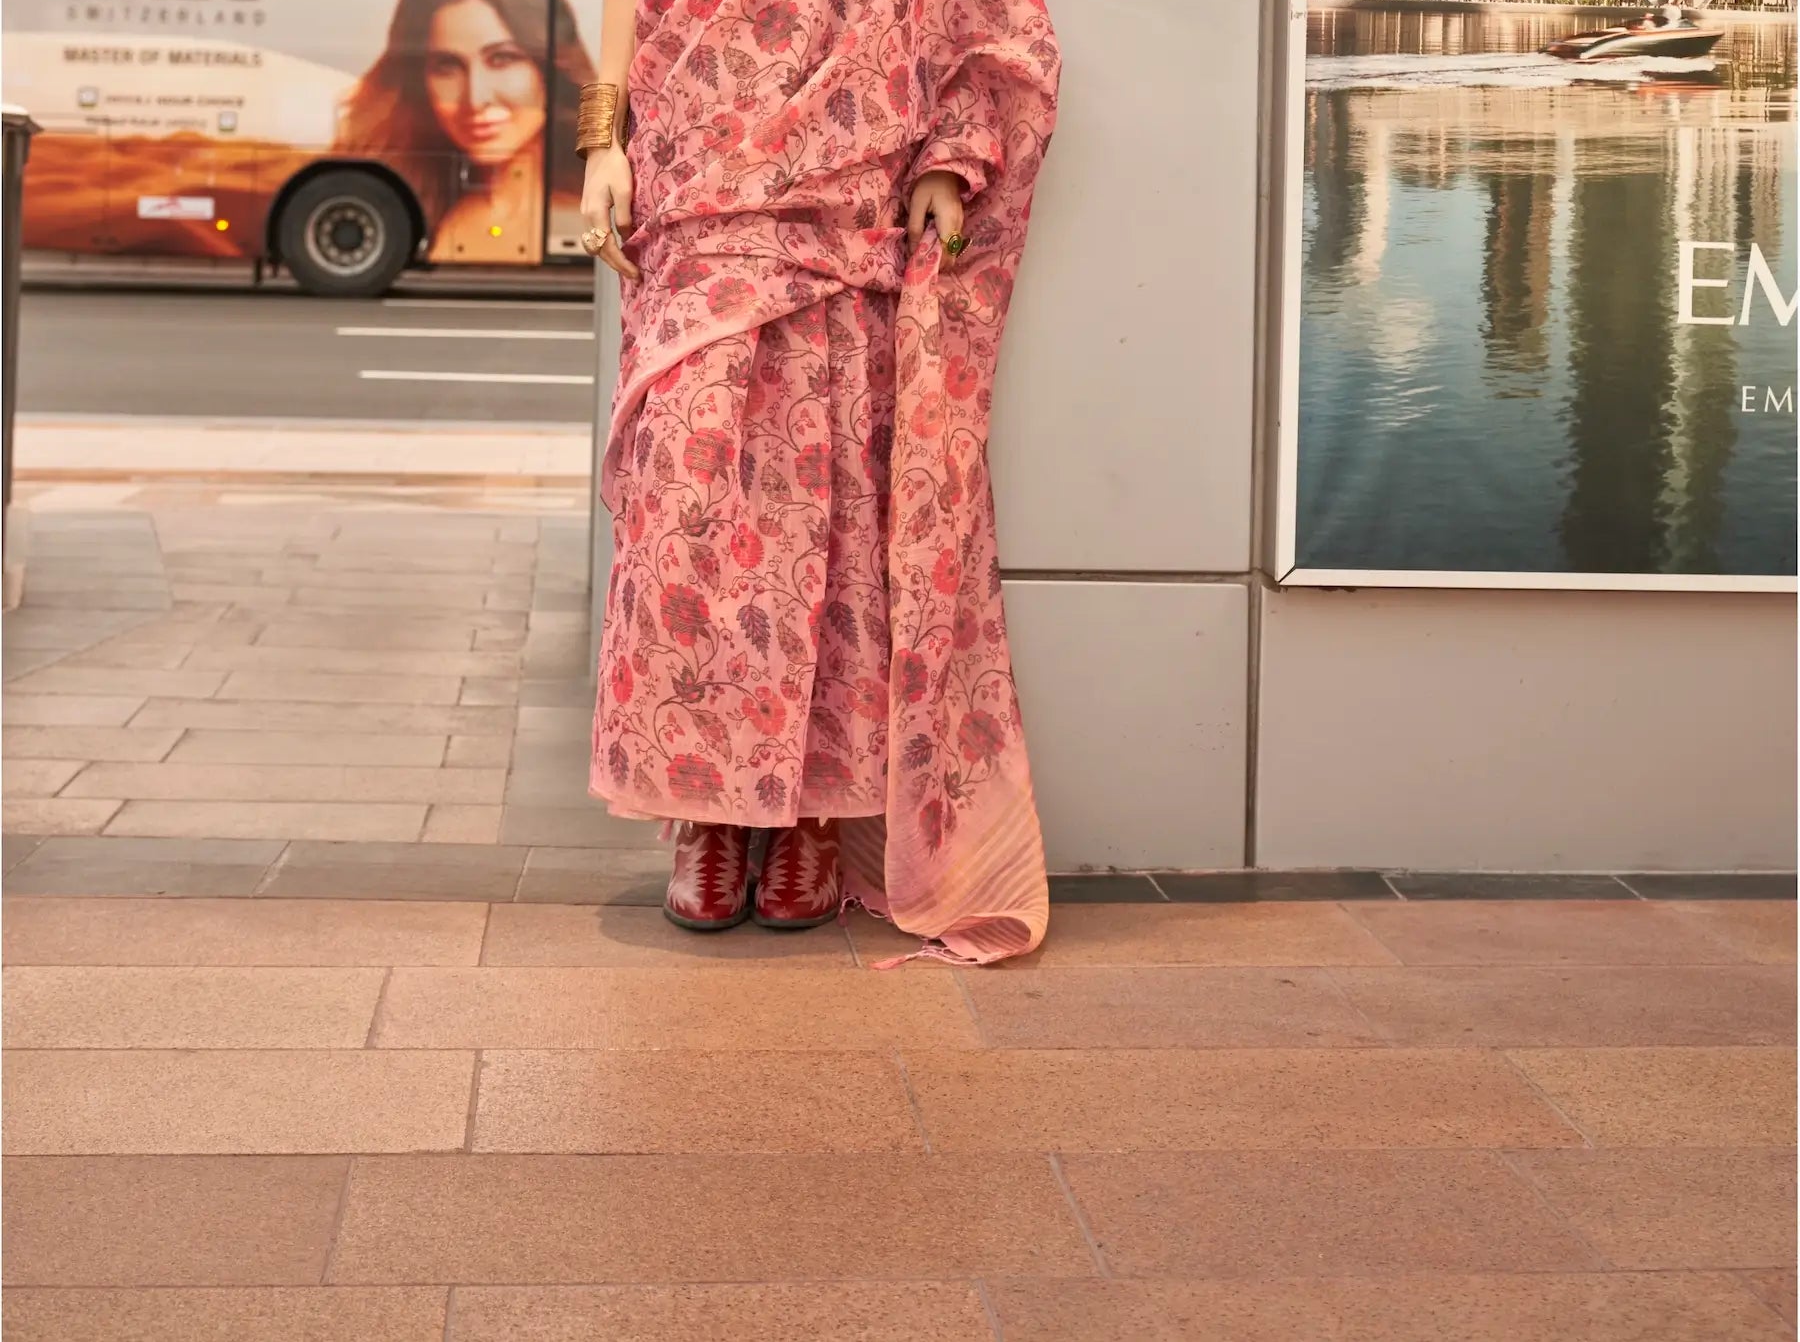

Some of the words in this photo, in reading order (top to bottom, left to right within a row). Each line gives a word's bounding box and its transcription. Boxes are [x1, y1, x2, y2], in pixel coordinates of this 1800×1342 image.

[66, 5, 267, 27] SWITZERLAND
[63, 46, 133, 64] MASTER
[137, 48, 160, 66] OF
[168, 49, 263, 68] MATERIALS
[1677, 241, 1798, 327] EM
[1741, 385, 1793, 413] EM
